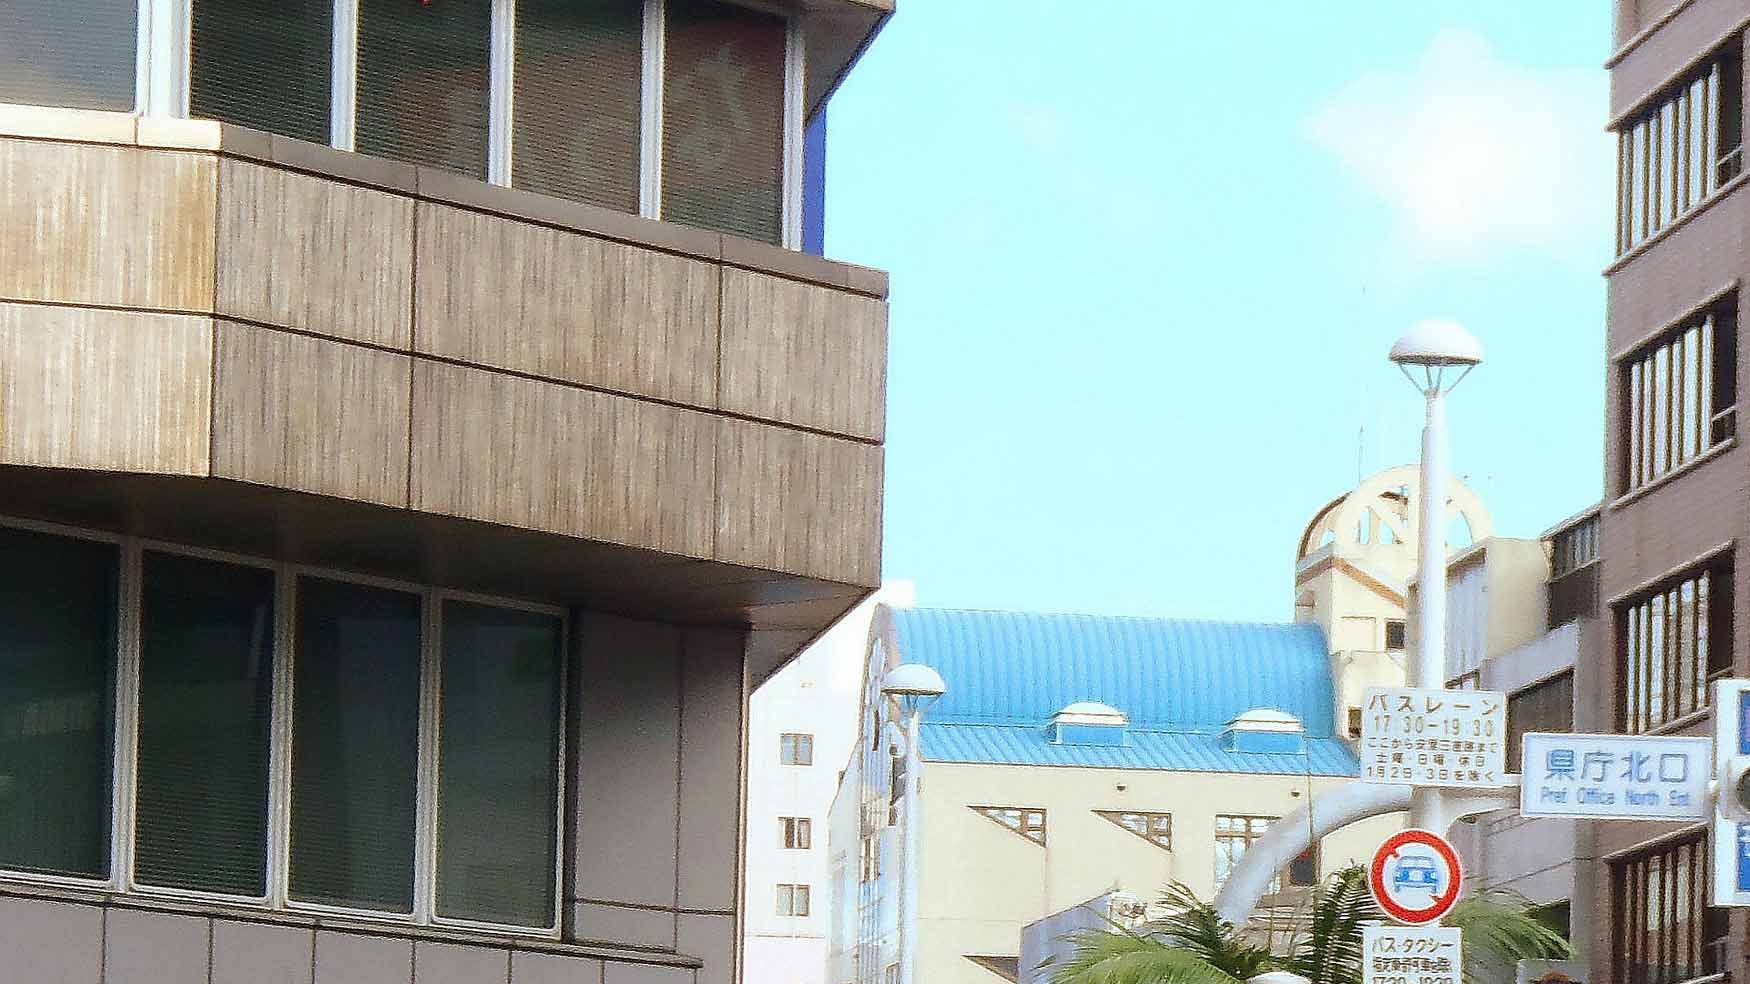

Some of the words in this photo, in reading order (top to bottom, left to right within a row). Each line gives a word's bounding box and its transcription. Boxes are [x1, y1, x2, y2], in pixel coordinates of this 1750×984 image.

[1369, 694, 1498, 716] バスレーン
[1545, 749, 1689, 783] 県庁北口
